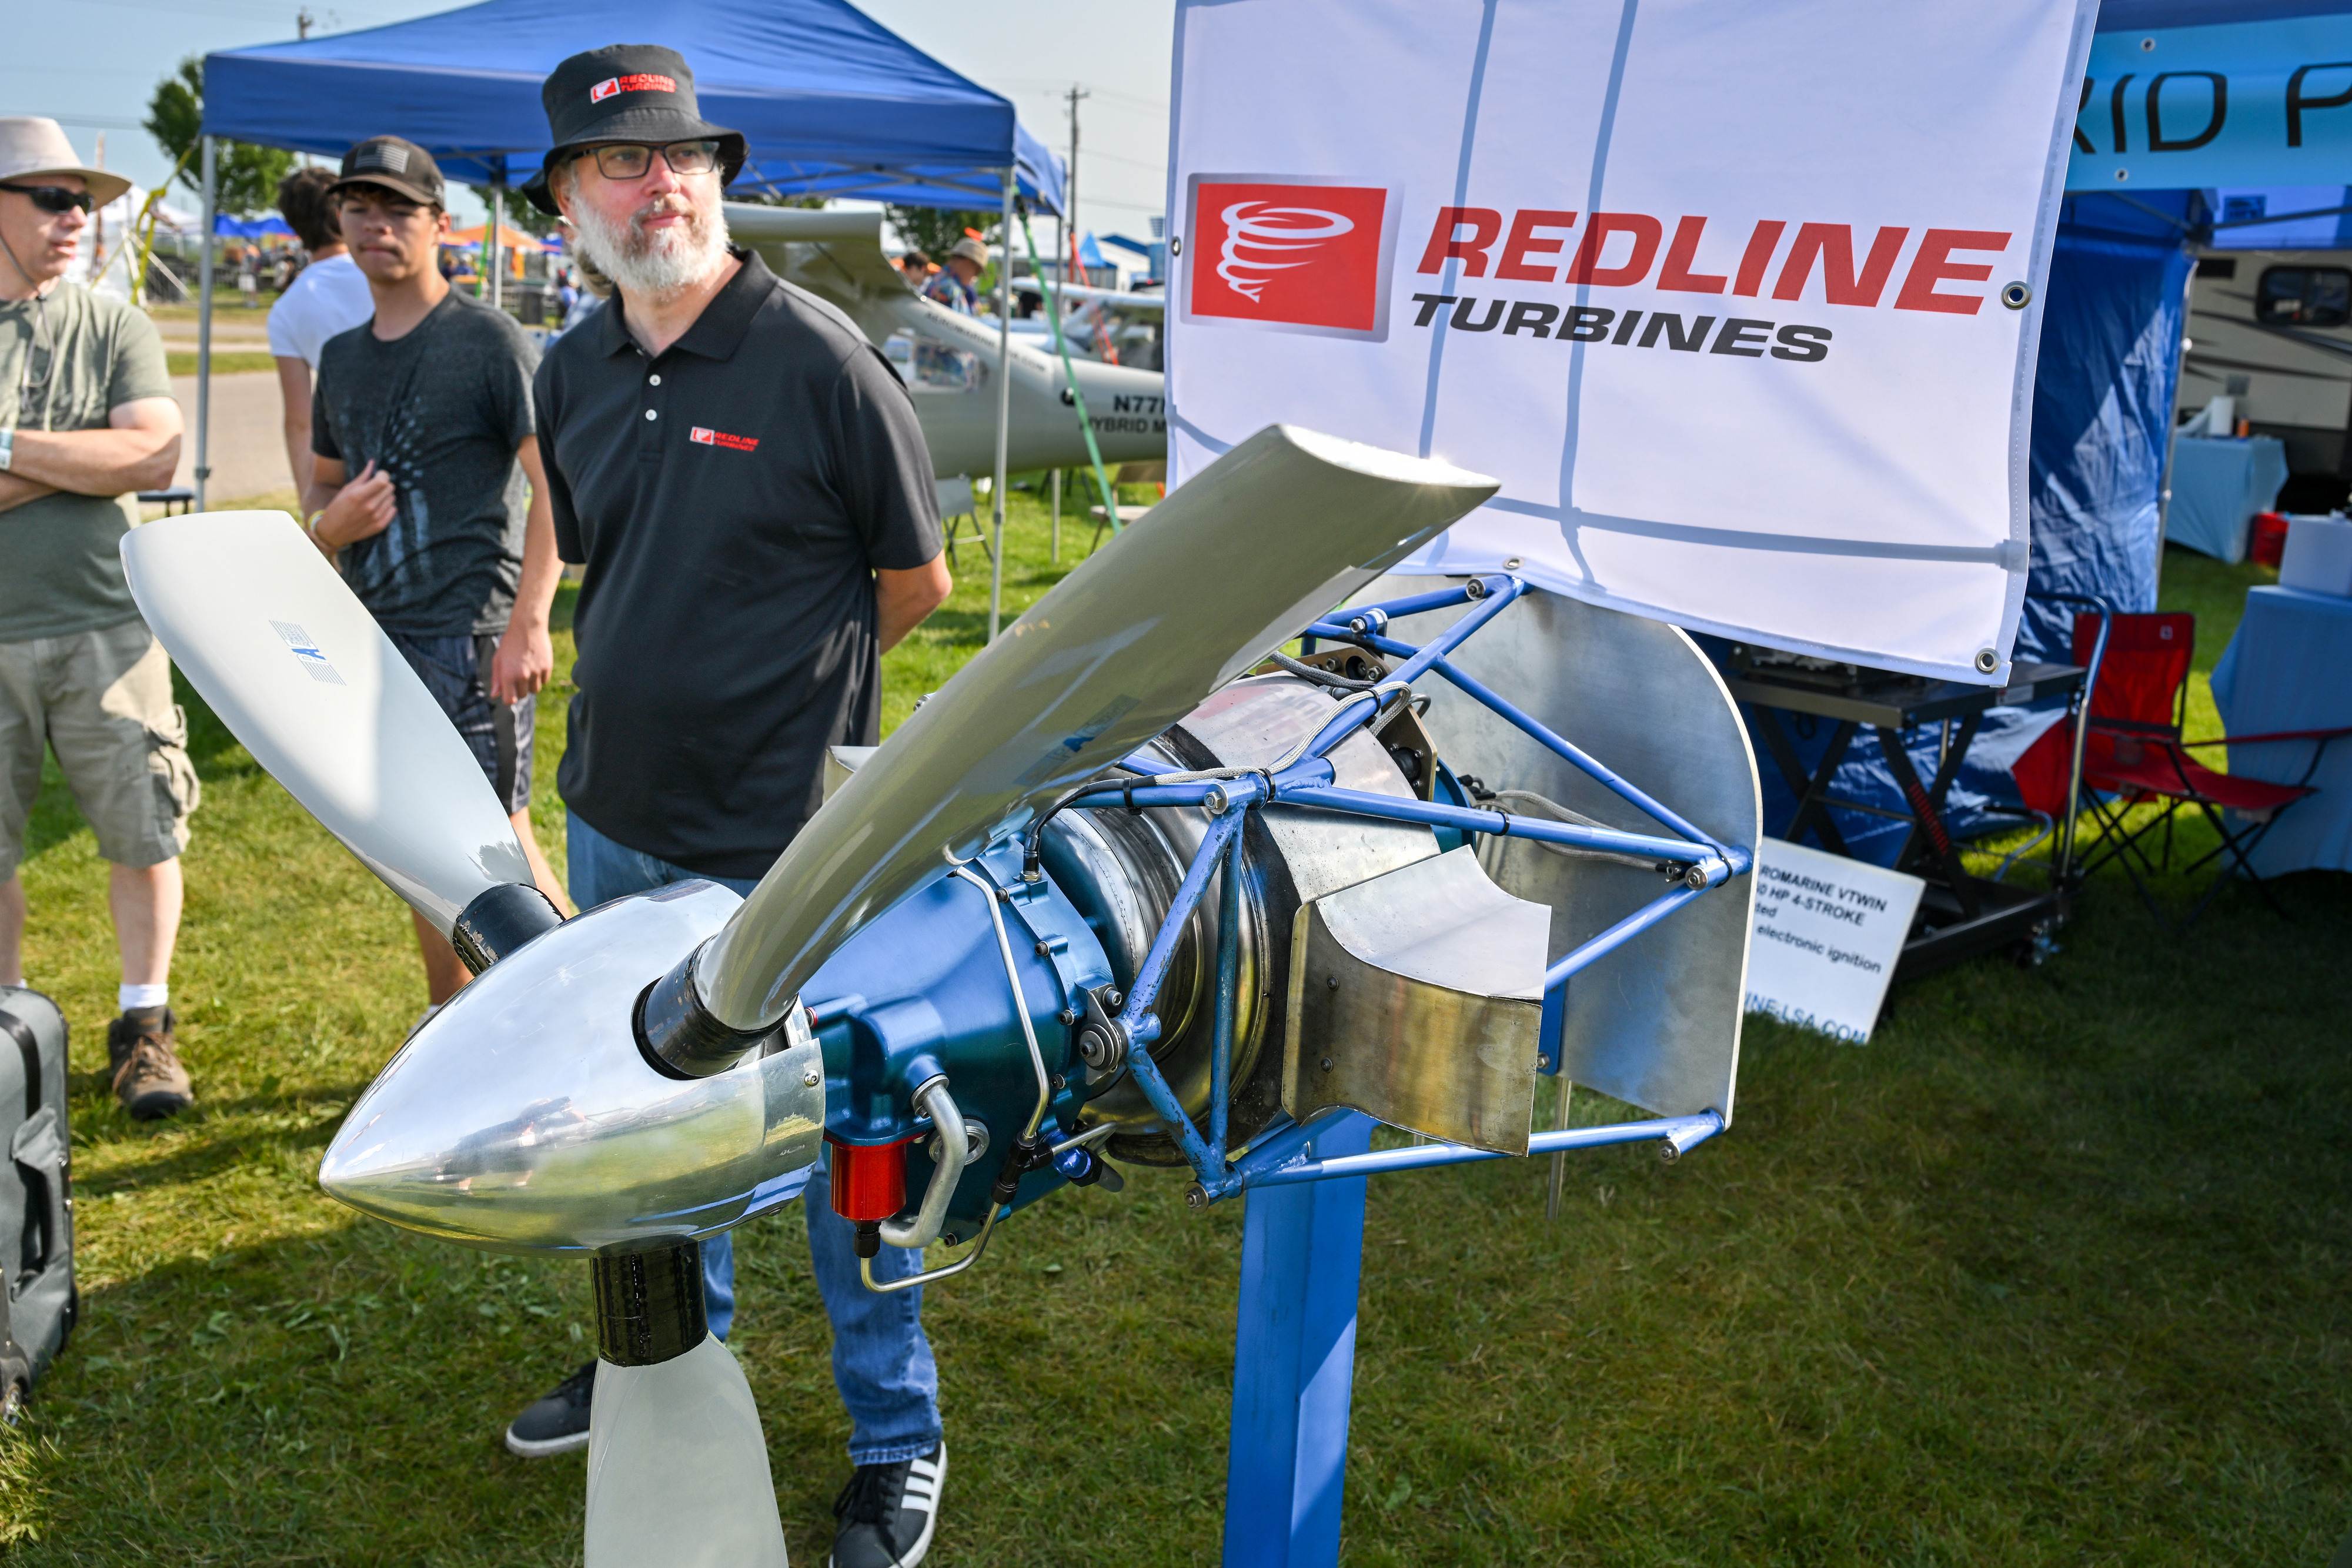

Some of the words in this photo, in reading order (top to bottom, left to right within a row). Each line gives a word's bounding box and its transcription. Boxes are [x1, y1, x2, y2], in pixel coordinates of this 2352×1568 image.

[619, 73, 675, 86] REDLINE
[620, 82, 676, 93] TURBINES
[1418, 207, 2011, 315] REDLINE
[1414, 294, 1832, 362] TURBINES
[1755, 902, 1778, 918] ted
[1759, 863, 1835, 898] ROMARINE
[1838, 887, 1888, 914] VTWIN
[1769, 886, 1790, 901] HP
[1792, 894, 1866, 927] 4-STROKE
[1756, 923, 1825, 955] electronic
[1827, 944, 1882, 974] ignition
